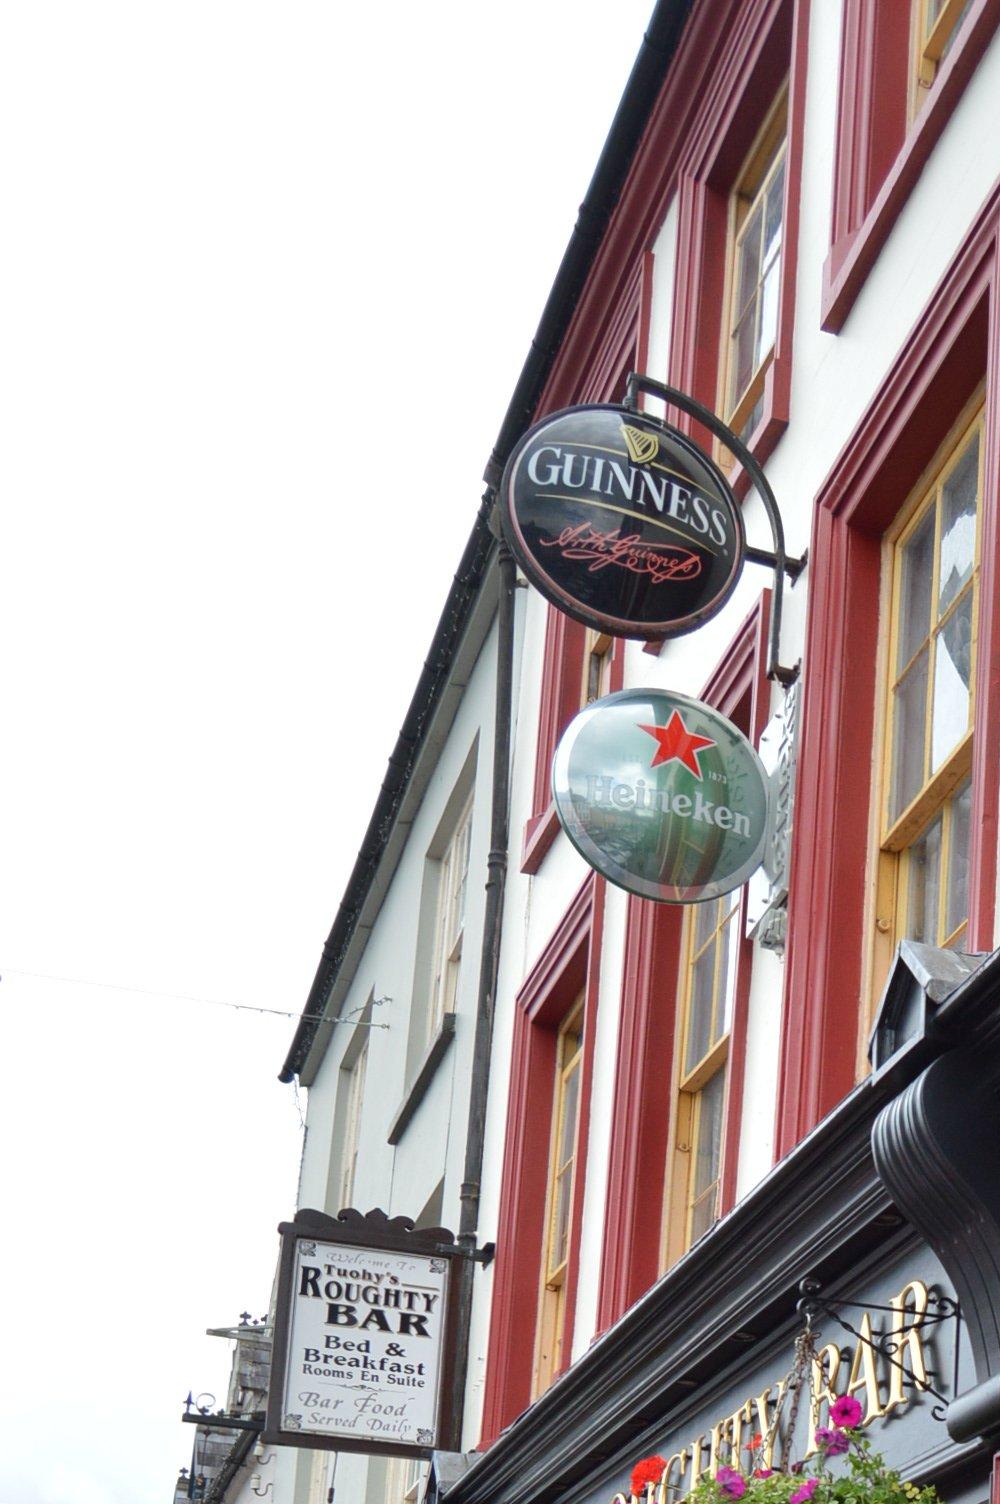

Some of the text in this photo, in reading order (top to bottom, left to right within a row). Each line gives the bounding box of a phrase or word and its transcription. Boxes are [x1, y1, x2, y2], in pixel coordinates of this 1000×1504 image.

[527, 446, 728, 547] GUINNESS
[708, 771, 728, 785] 1873
[585, 774, 752, 839] Heineken
[299, 1265, 440, 1315] ROUGHTY
[323, 1264, 399, 1287] Tuohy's
[324, 1302, 432, 1339] BAR
[323, 1335, 406, 1358] Bed &
[302, 1363, 426, 1388] Rooms En Suite
[303, 1347, 426, 1376] Breakfast
[805, 1280, 930, 1458] BAR
[297, 1391, 416, 1417] Bar Food
[307, 1411, 413, 1440] Served Daily
